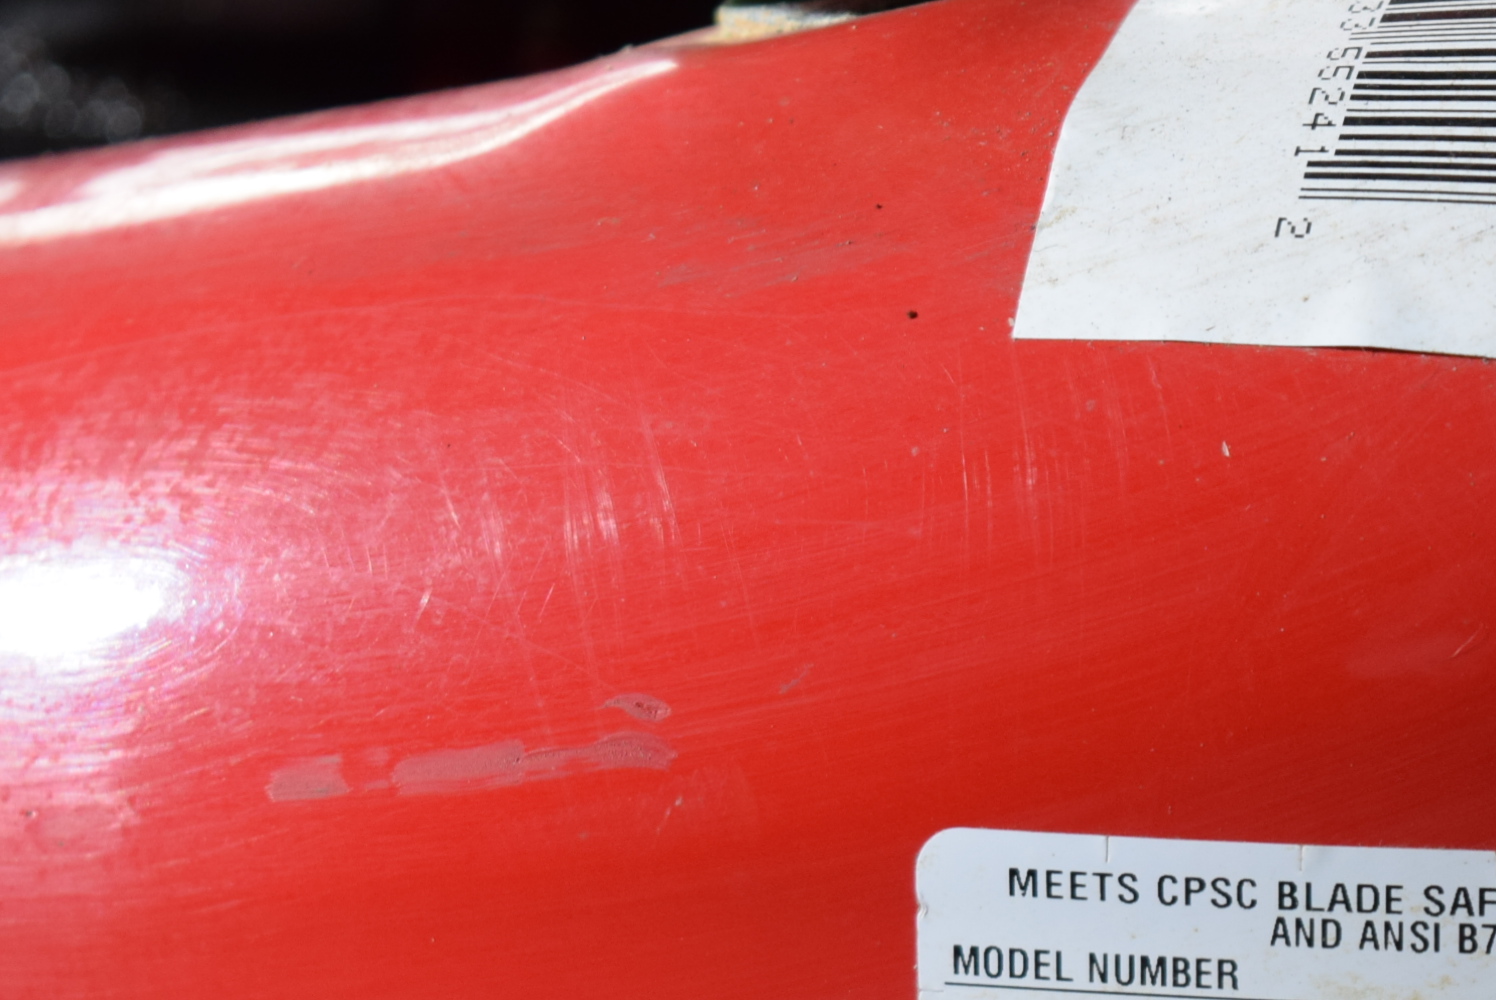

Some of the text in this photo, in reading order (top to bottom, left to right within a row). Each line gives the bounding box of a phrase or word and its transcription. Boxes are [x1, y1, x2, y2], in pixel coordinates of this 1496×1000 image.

[1294, 46, 1363, 157] 55241
[1274, 217, 1312, 238] 2
[1008, 867, 1140, 905] MEETS
[1157, 874, 1258, 909] CPSC
[1277, 881, 1404, 915] BLADE
[1271, 917, 1342, 949] AND
[1359, 921, 1441, 953] ANSI
[952, 944, 1239, 991] MODEL NUMBER
